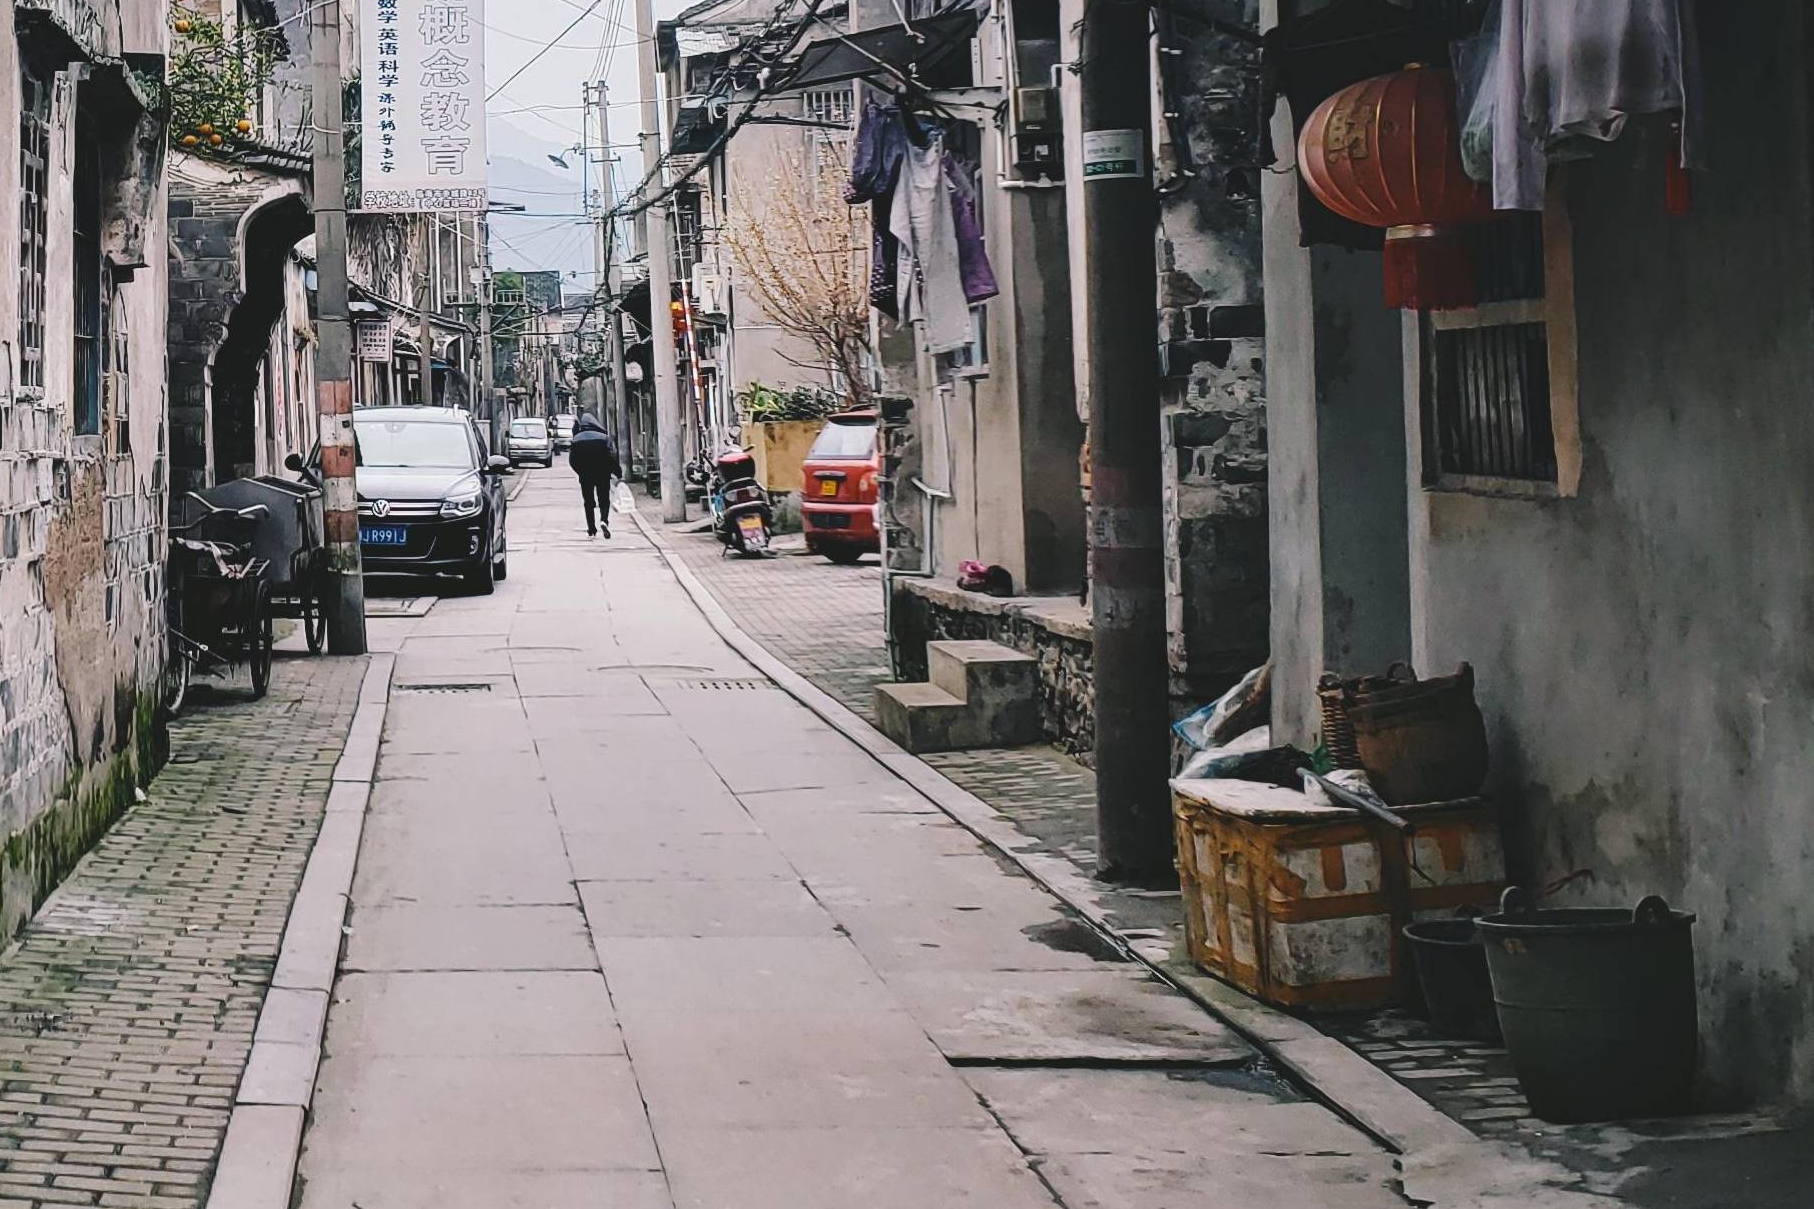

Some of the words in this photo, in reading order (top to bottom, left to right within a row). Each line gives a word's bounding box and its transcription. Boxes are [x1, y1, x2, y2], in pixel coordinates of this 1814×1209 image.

[377, 28, 399, 56] 英语
[377, 60, 399, 88] 科学
[359, 529, 407, 543] JR991J
